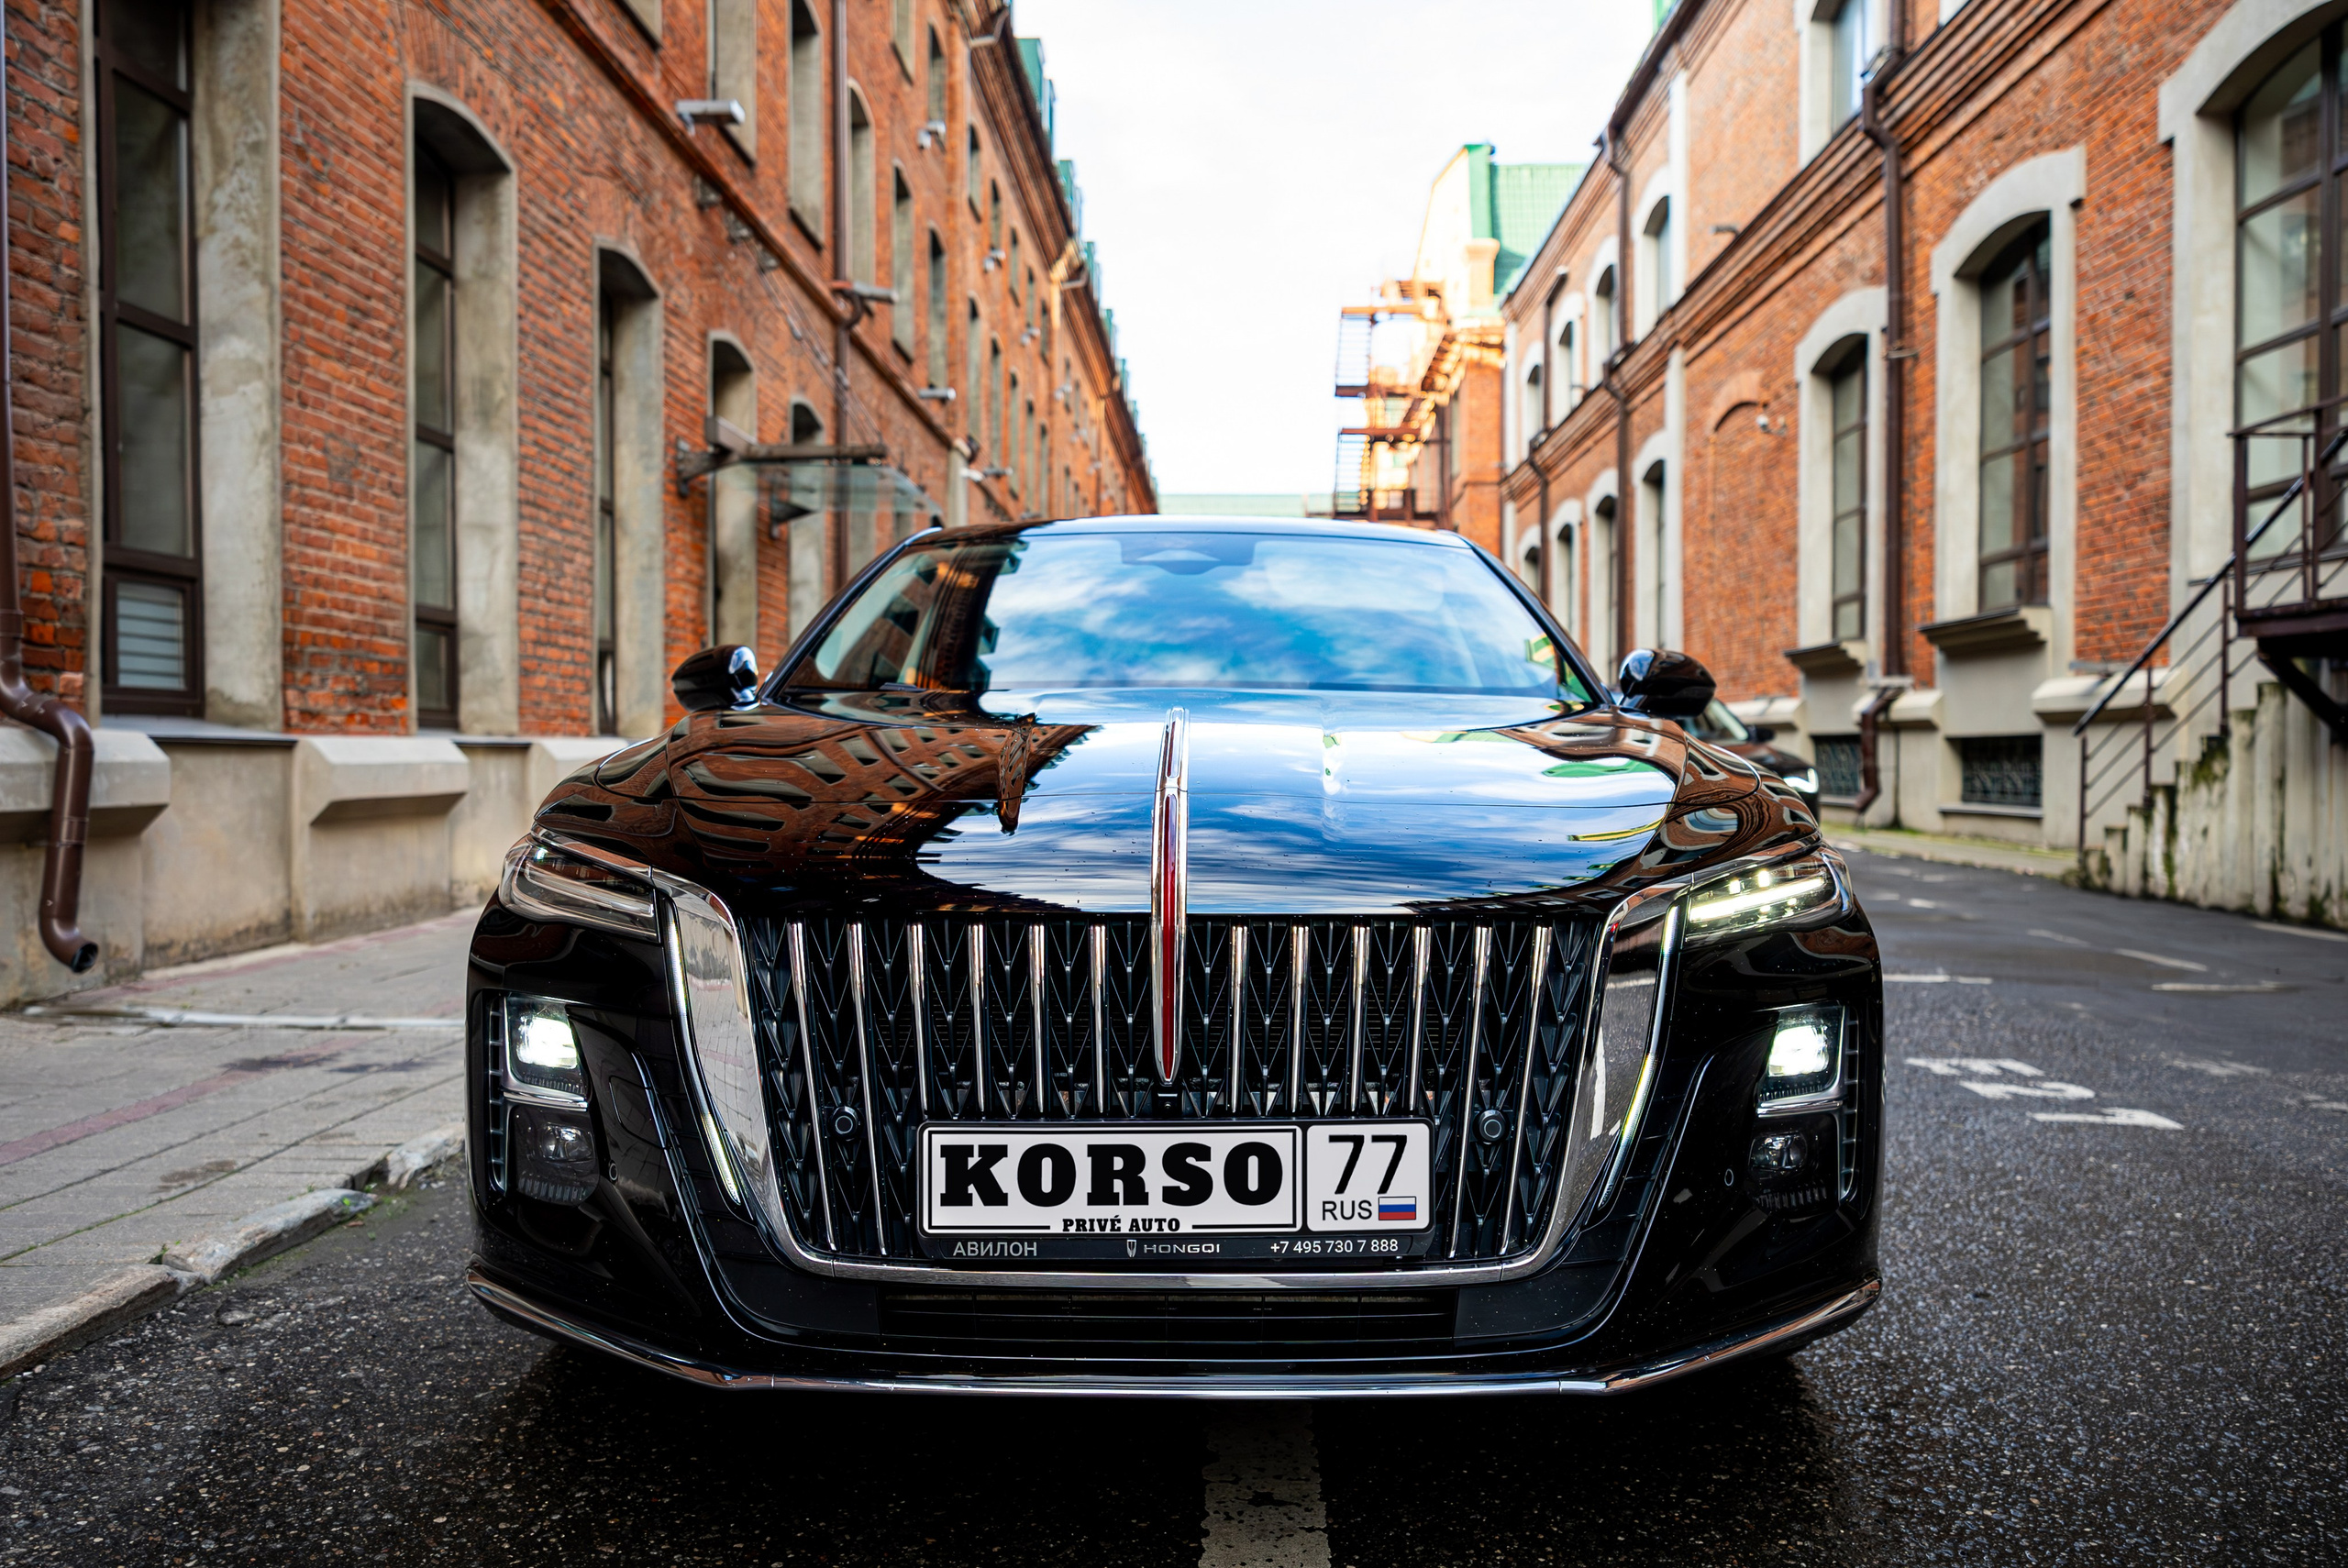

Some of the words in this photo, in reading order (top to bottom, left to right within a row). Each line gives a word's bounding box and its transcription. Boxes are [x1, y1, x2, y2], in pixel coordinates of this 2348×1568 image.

[1328, 1134, 1408, 1195] 77
[939, 1141, 1283, 1208] KORSO
[1322, 1199, 1373, 1221] RUS
[1062, 1214, 1122, 1233] PRIVÉ
[1128, 1217, 1180, 1232] AUTO
[952, 1241, 1037, 1257] АВИЛОН
[1143, 1242, 1221, 1254] HONGQI
[1269, 1241, 1290, 1254] +7
[1292, 1241, 1322, 1253] 495
[1326, 1240, 1354, 1253] 730
[1357, 1240, 1367, 1253] 7
[1370, 1239, 1400, 1253] 888
